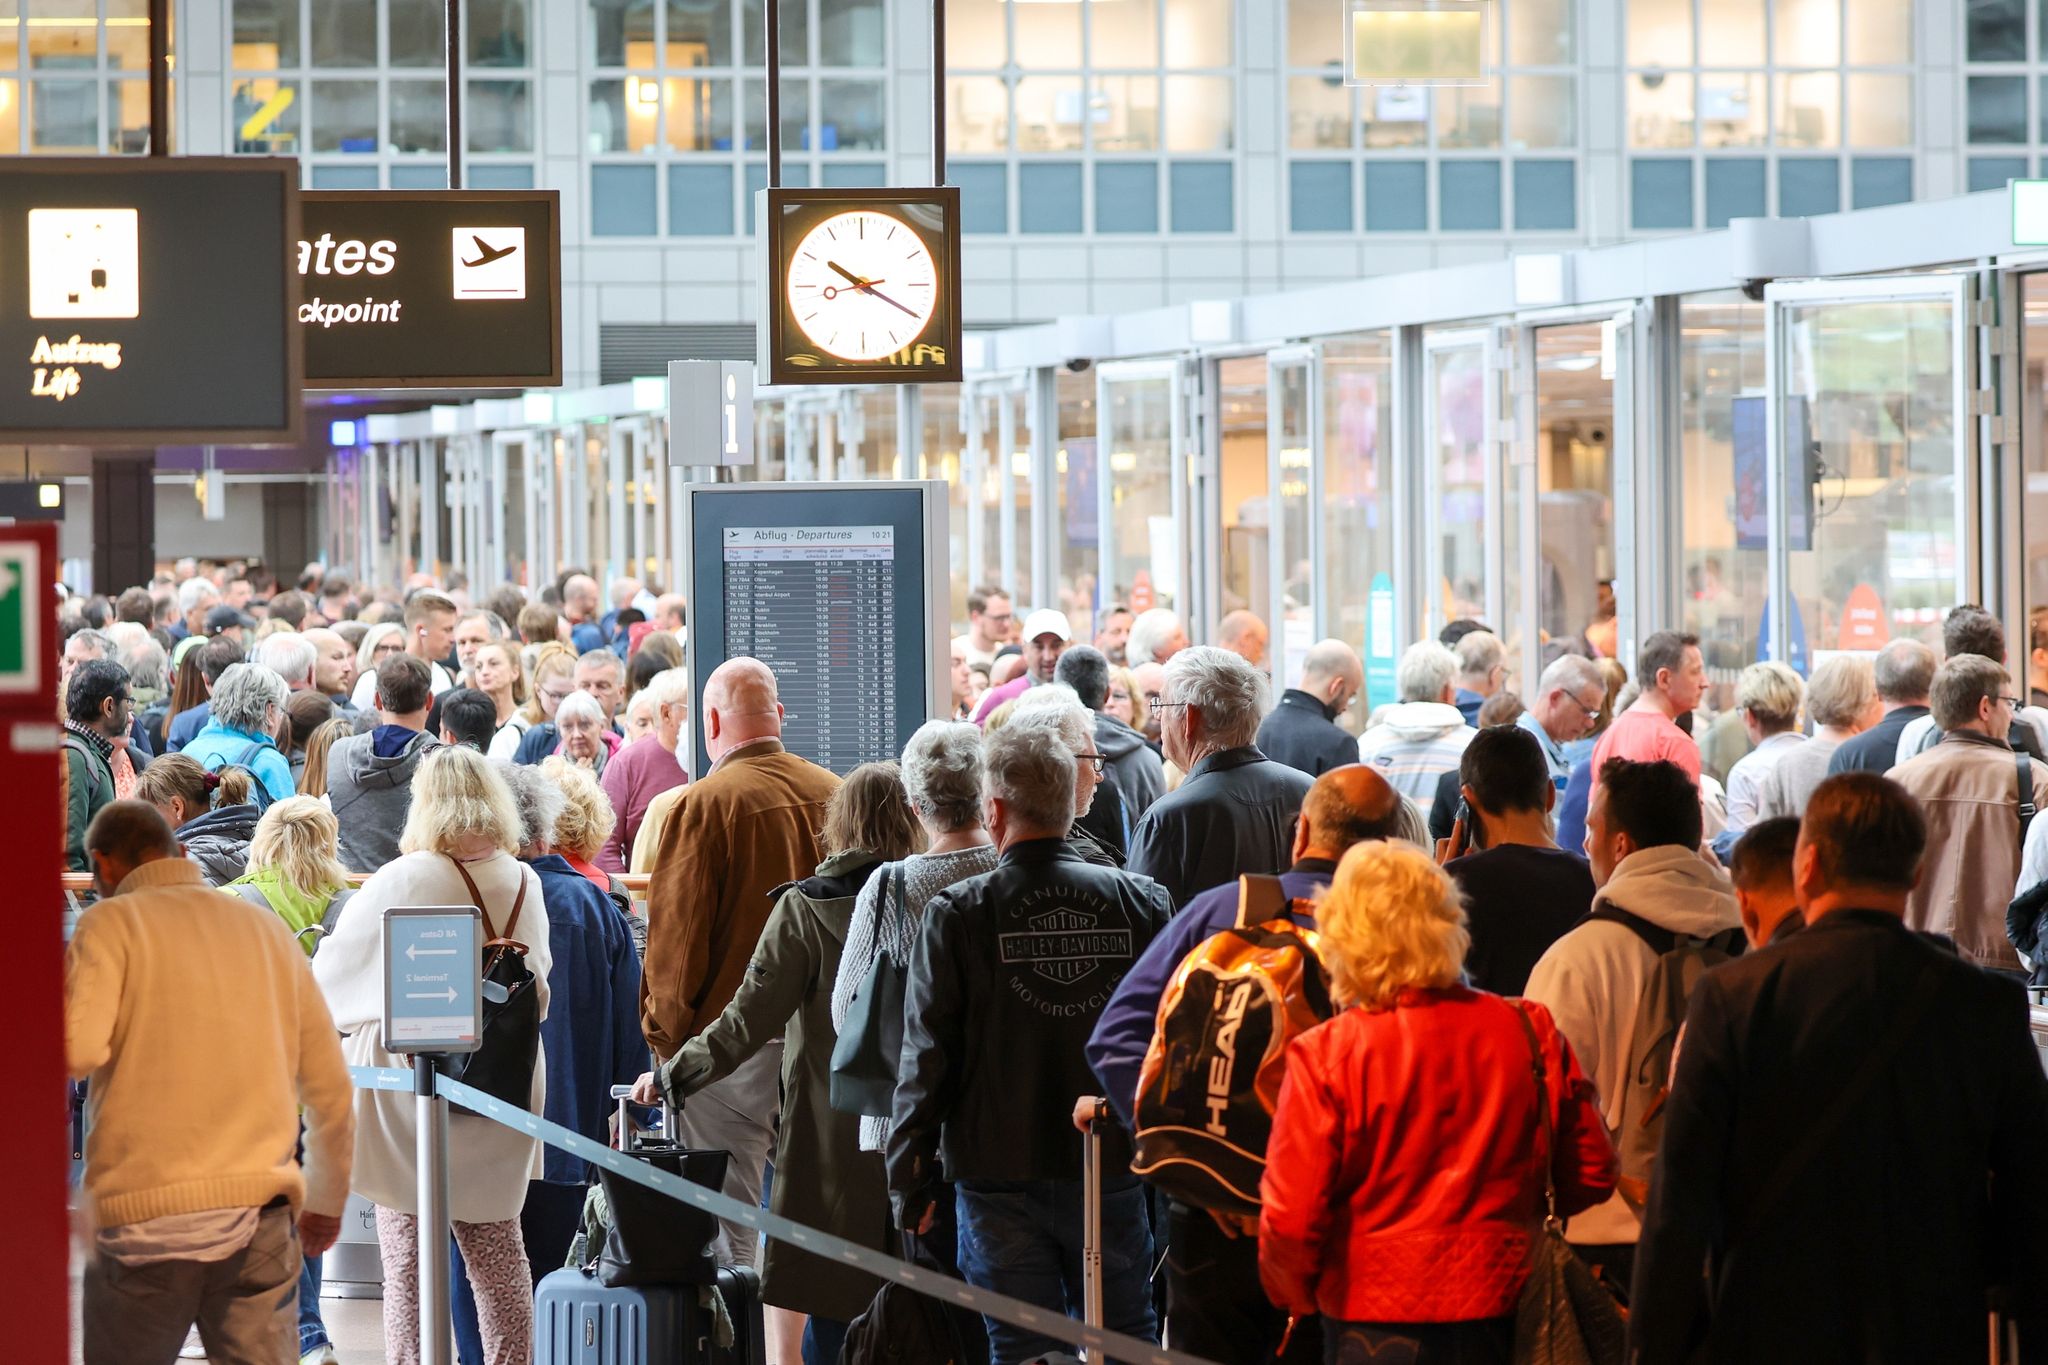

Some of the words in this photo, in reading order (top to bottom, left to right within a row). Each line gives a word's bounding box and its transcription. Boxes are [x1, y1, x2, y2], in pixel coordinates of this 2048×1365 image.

[299, 297, 402, 328] ckpoint
[30, 334, 122, 369] Aufzug
[31, 366, 81, 401] Lift
[754, 530, 787, 542] Abflug
[796, 530, 852, 541] Departures
[1038, 911, 1088, 930] MOTOR
[1006, 935, 1127, 957] HARLEY-DAVIDSON
[1039, 960, 1091, 978] CYCLES
